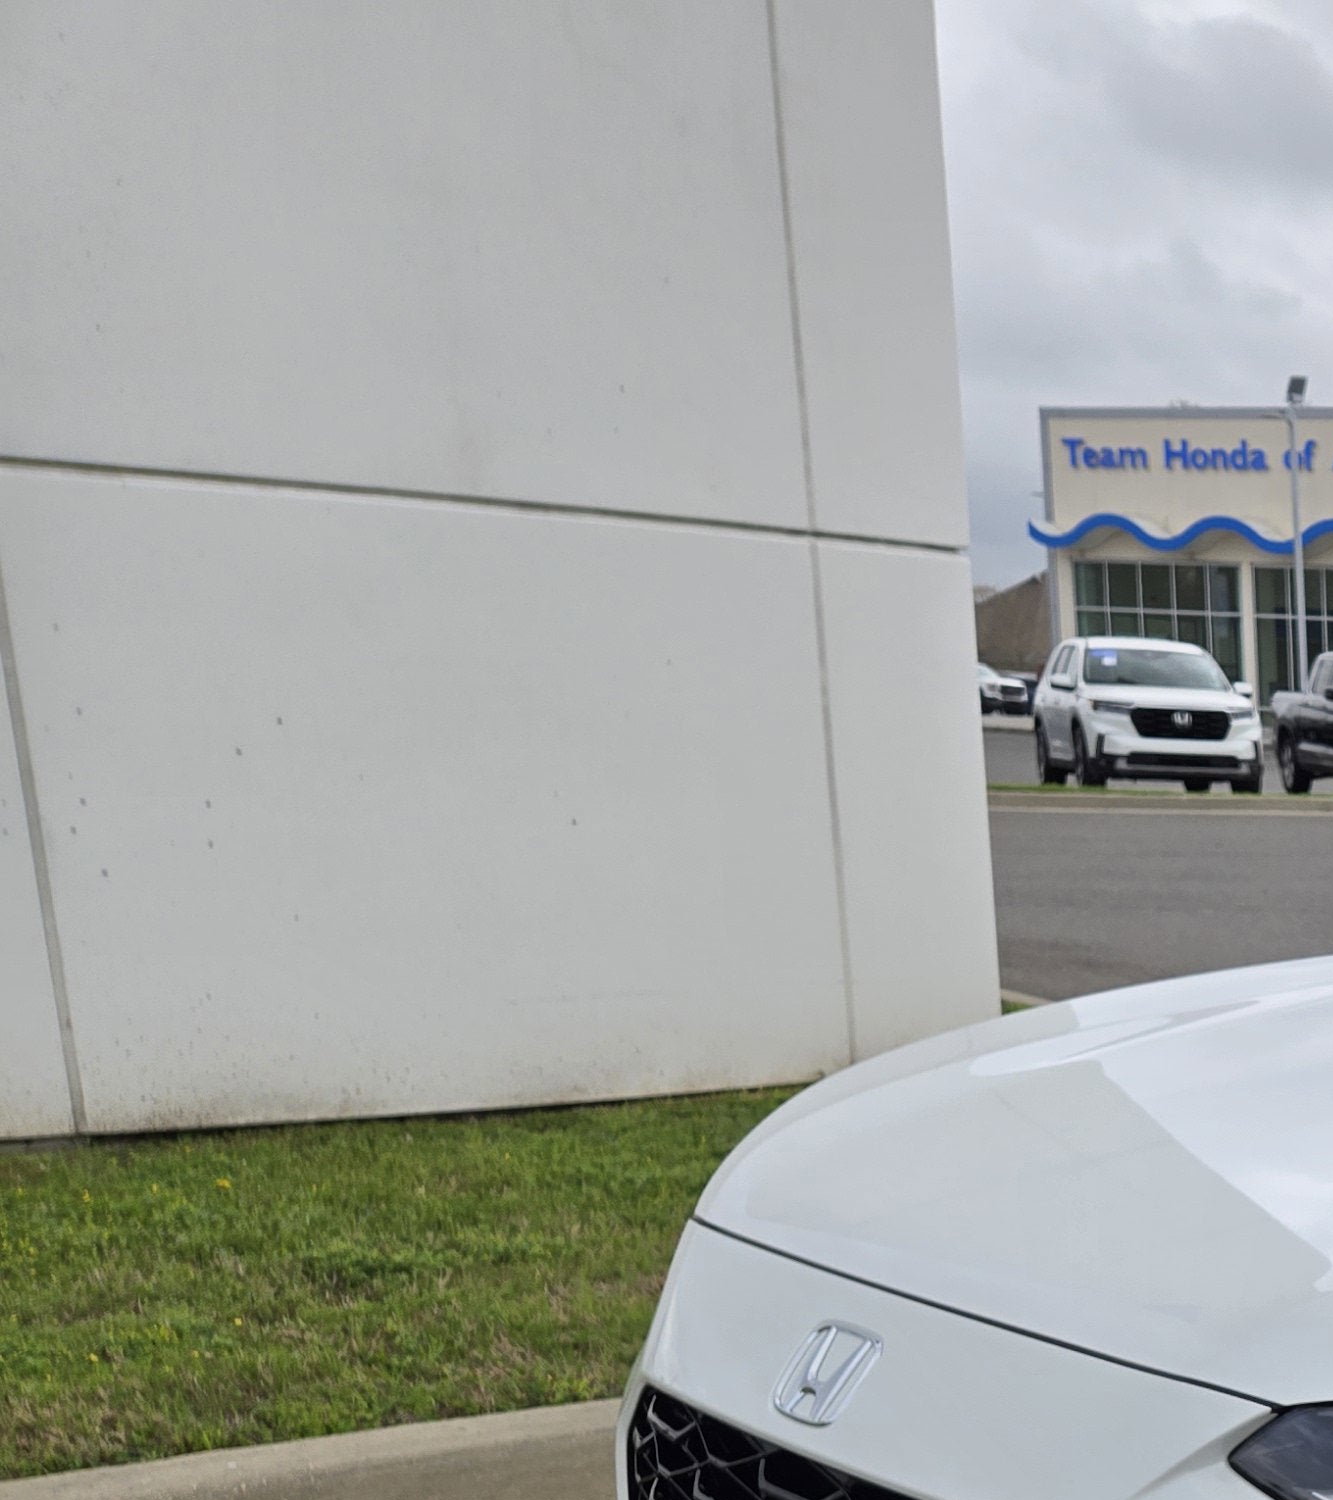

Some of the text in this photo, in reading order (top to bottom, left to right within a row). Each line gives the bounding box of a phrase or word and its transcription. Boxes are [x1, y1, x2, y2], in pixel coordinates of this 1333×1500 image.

[1061, 437, 1149, 470] Team
[1162, 437, 1269, 472] Honda
[1284, 439, 1316, 472] of
